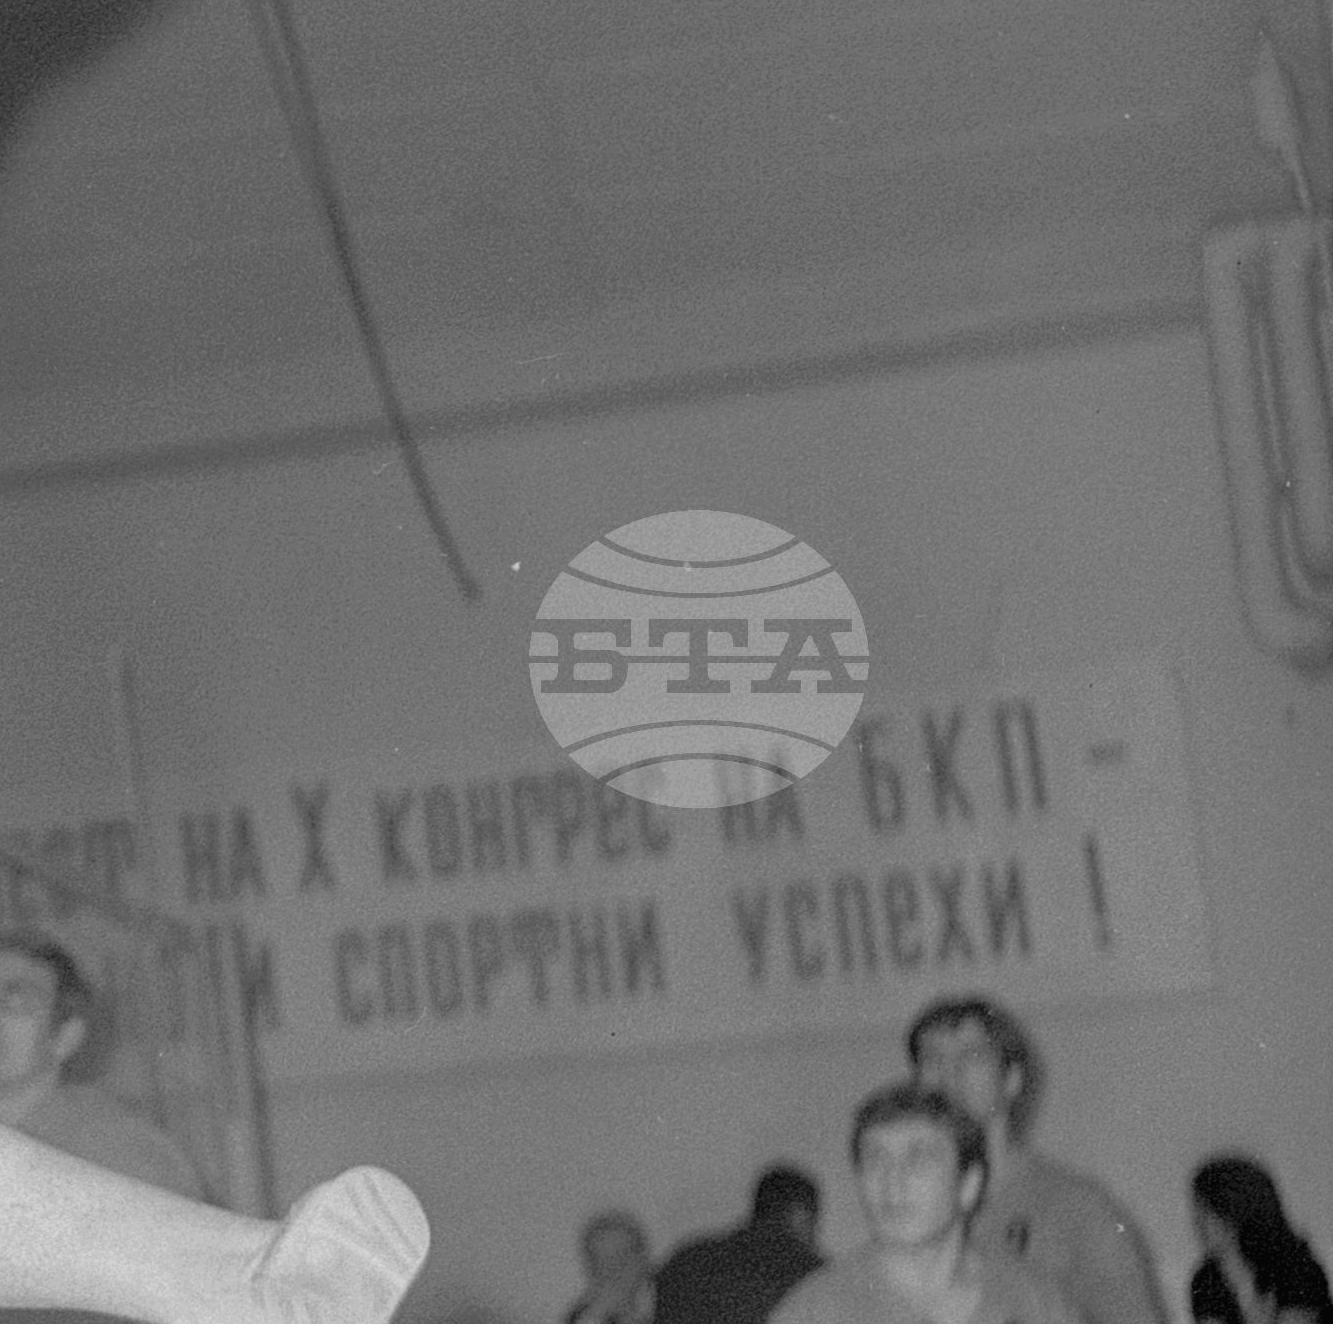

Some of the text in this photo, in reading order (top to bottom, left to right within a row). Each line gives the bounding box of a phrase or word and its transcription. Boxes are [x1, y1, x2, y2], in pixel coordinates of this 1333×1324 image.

[178, 807, 266, 905] НА
[718, 745, 807, 843] НА
[855, 695, 1047, 835] БКП
[335, 901, 667, 1025] СПОРТНИ
[733, 859, 1032, 983] УСПЕХИ
